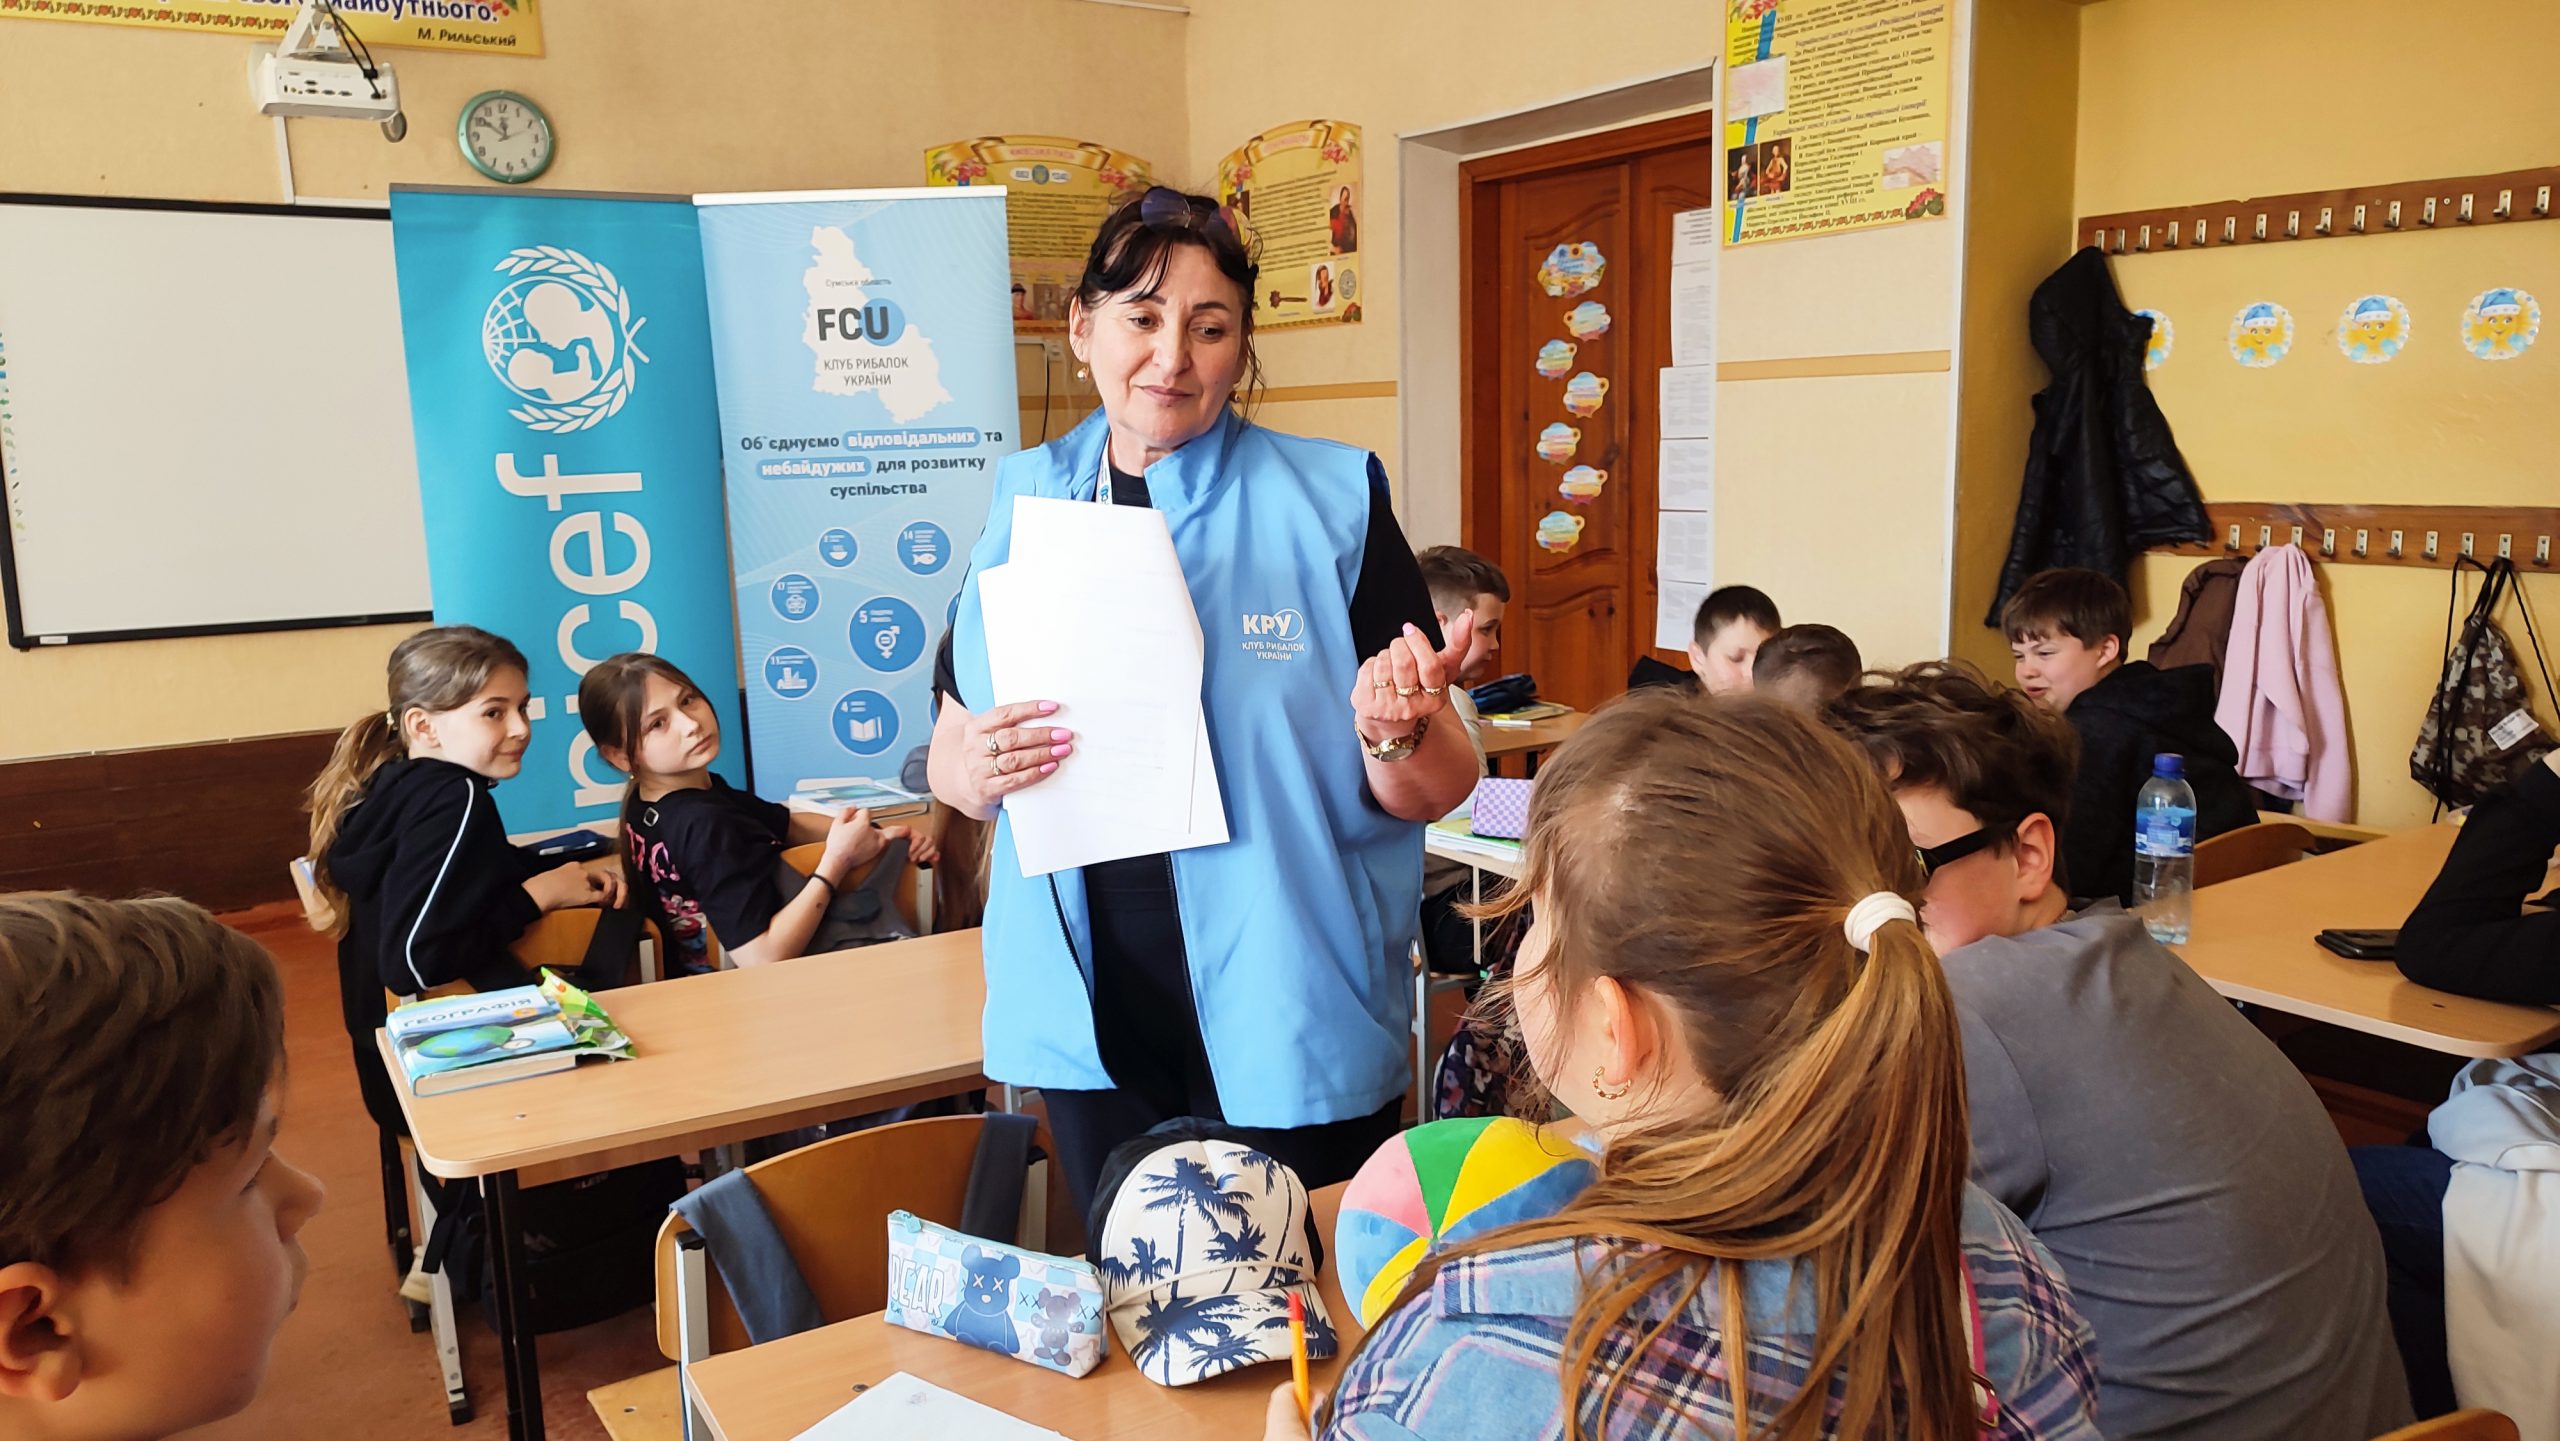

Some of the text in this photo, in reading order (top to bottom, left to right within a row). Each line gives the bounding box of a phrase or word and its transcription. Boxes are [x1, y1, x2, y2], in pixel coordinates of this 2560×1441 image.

[417, 28, 517, 47] М. Рильський
[817, 306, 890, 341] FCU
[824, 357, 909, 370] КЛУБ РИБАЛОК
[844, 373, 891, 386] УКРАЇНИ
[847, 430, 976, 448] відповідальних
[985, 430, 1002, 443] та
[762, 456, 985, 478] небайдужих для розвитку
[830, 482, 927, 499] суспільства
[903, 530, 914, 541] 14
[858, 609, 868, 624] 5
[1242, 614, 1292, 637] КРУ
[1242, 641, 1305, 652] КЛУБ РИБАЛОК
[1256, 651, 1292, 662] УКРАЇНИ
[403, 997, 533, 1029] ГЕОГРАФІЯ
